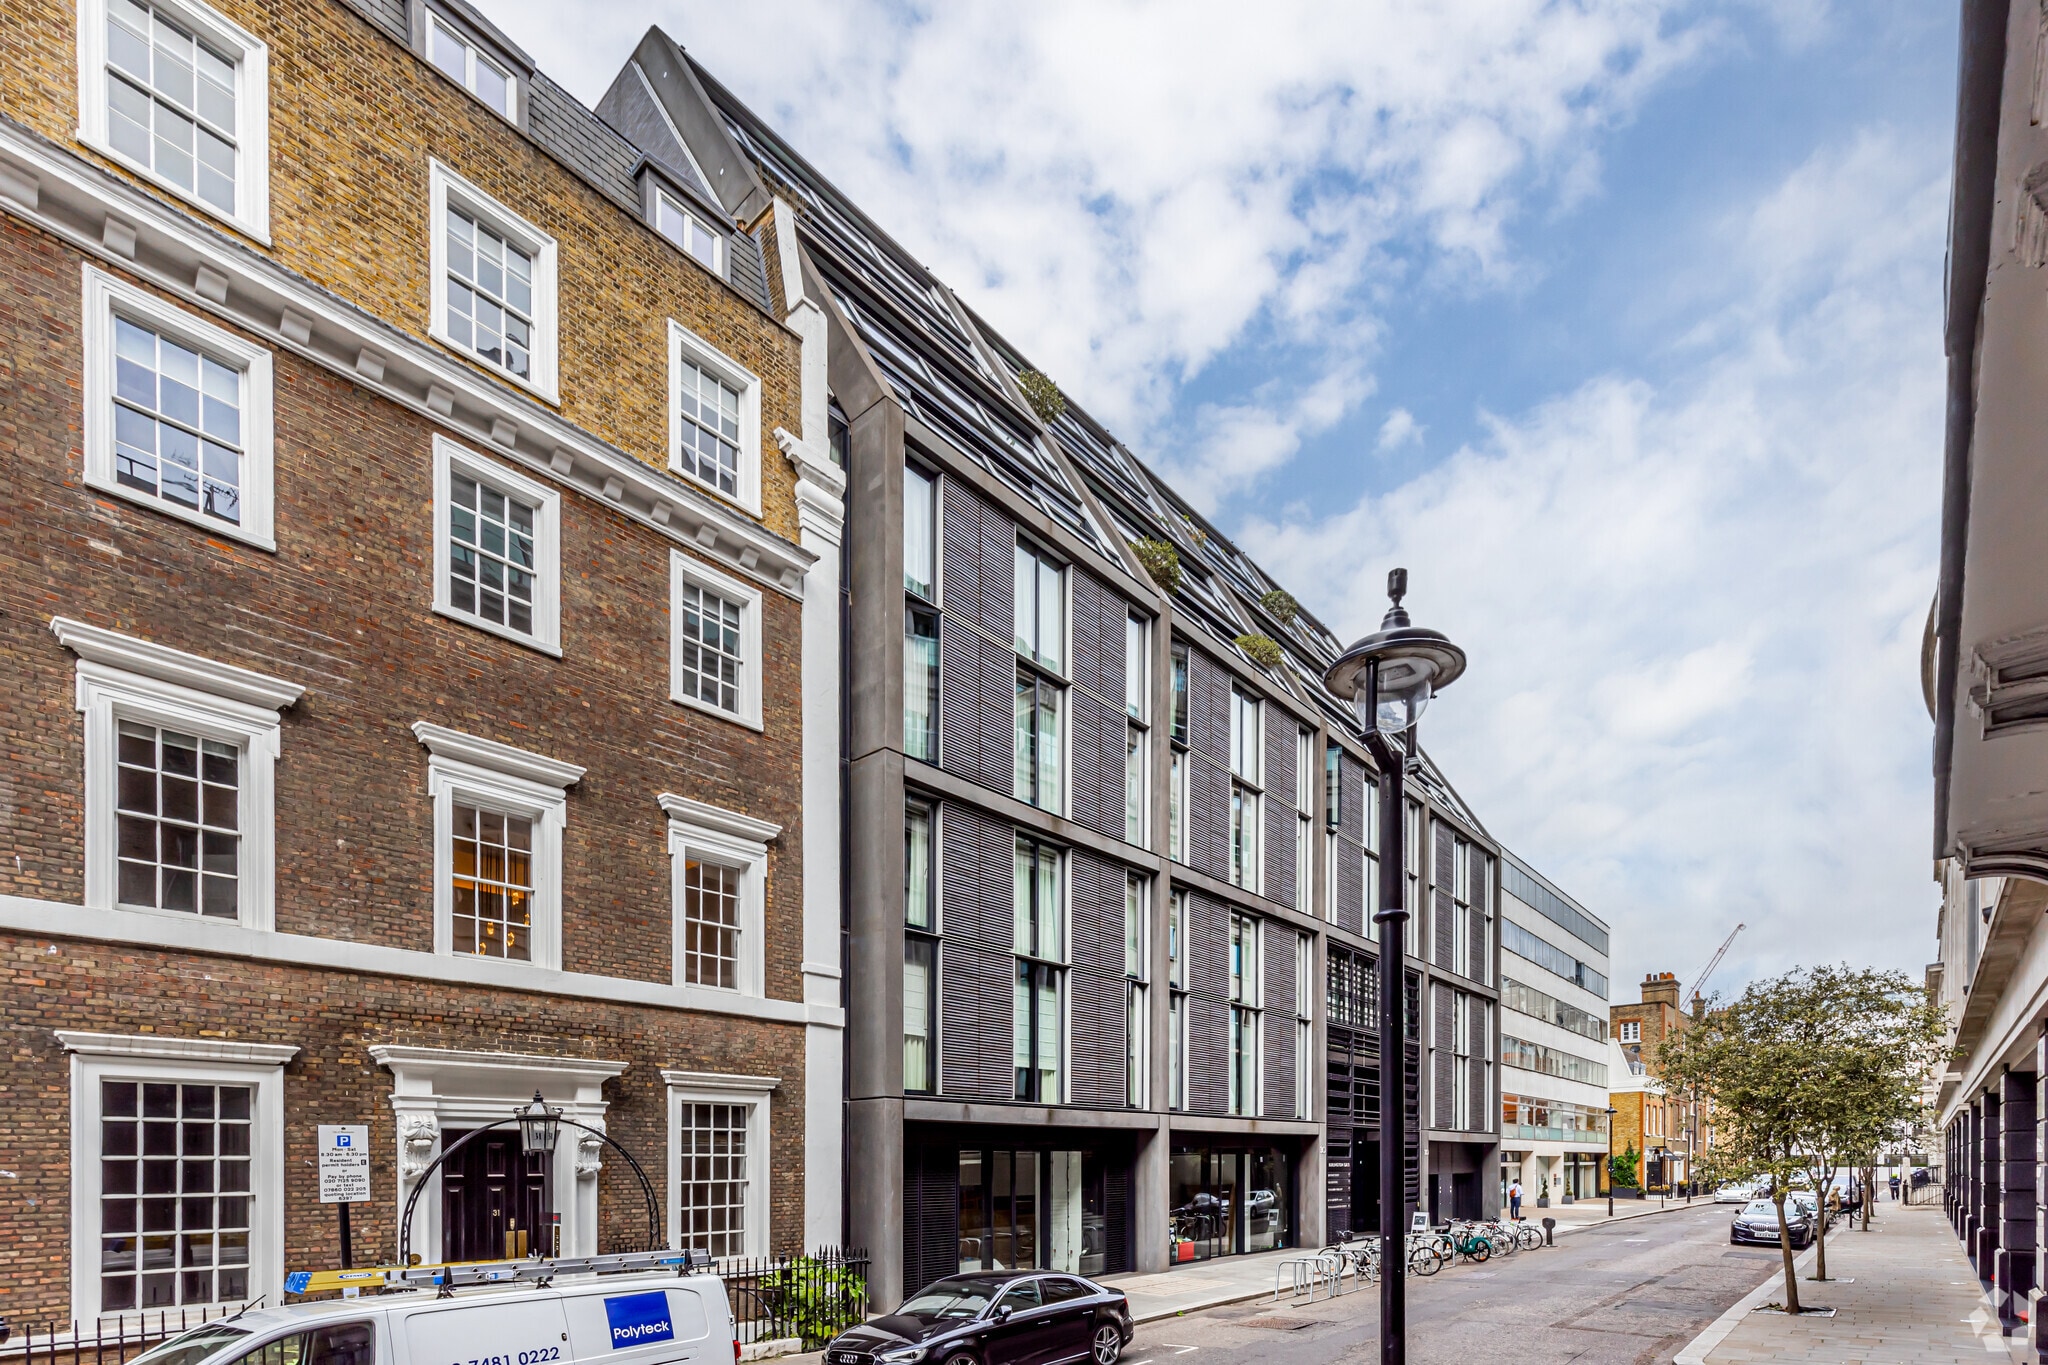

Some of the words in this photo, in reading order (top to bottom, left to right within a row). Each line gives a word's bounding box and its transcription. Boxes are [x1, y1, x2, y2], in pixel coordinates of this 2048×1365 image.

[340, 1136, 348, 1146] P
[613, 1320, 670, 1340] Polyteck
[518, 1346, 560, 1365] 0222
